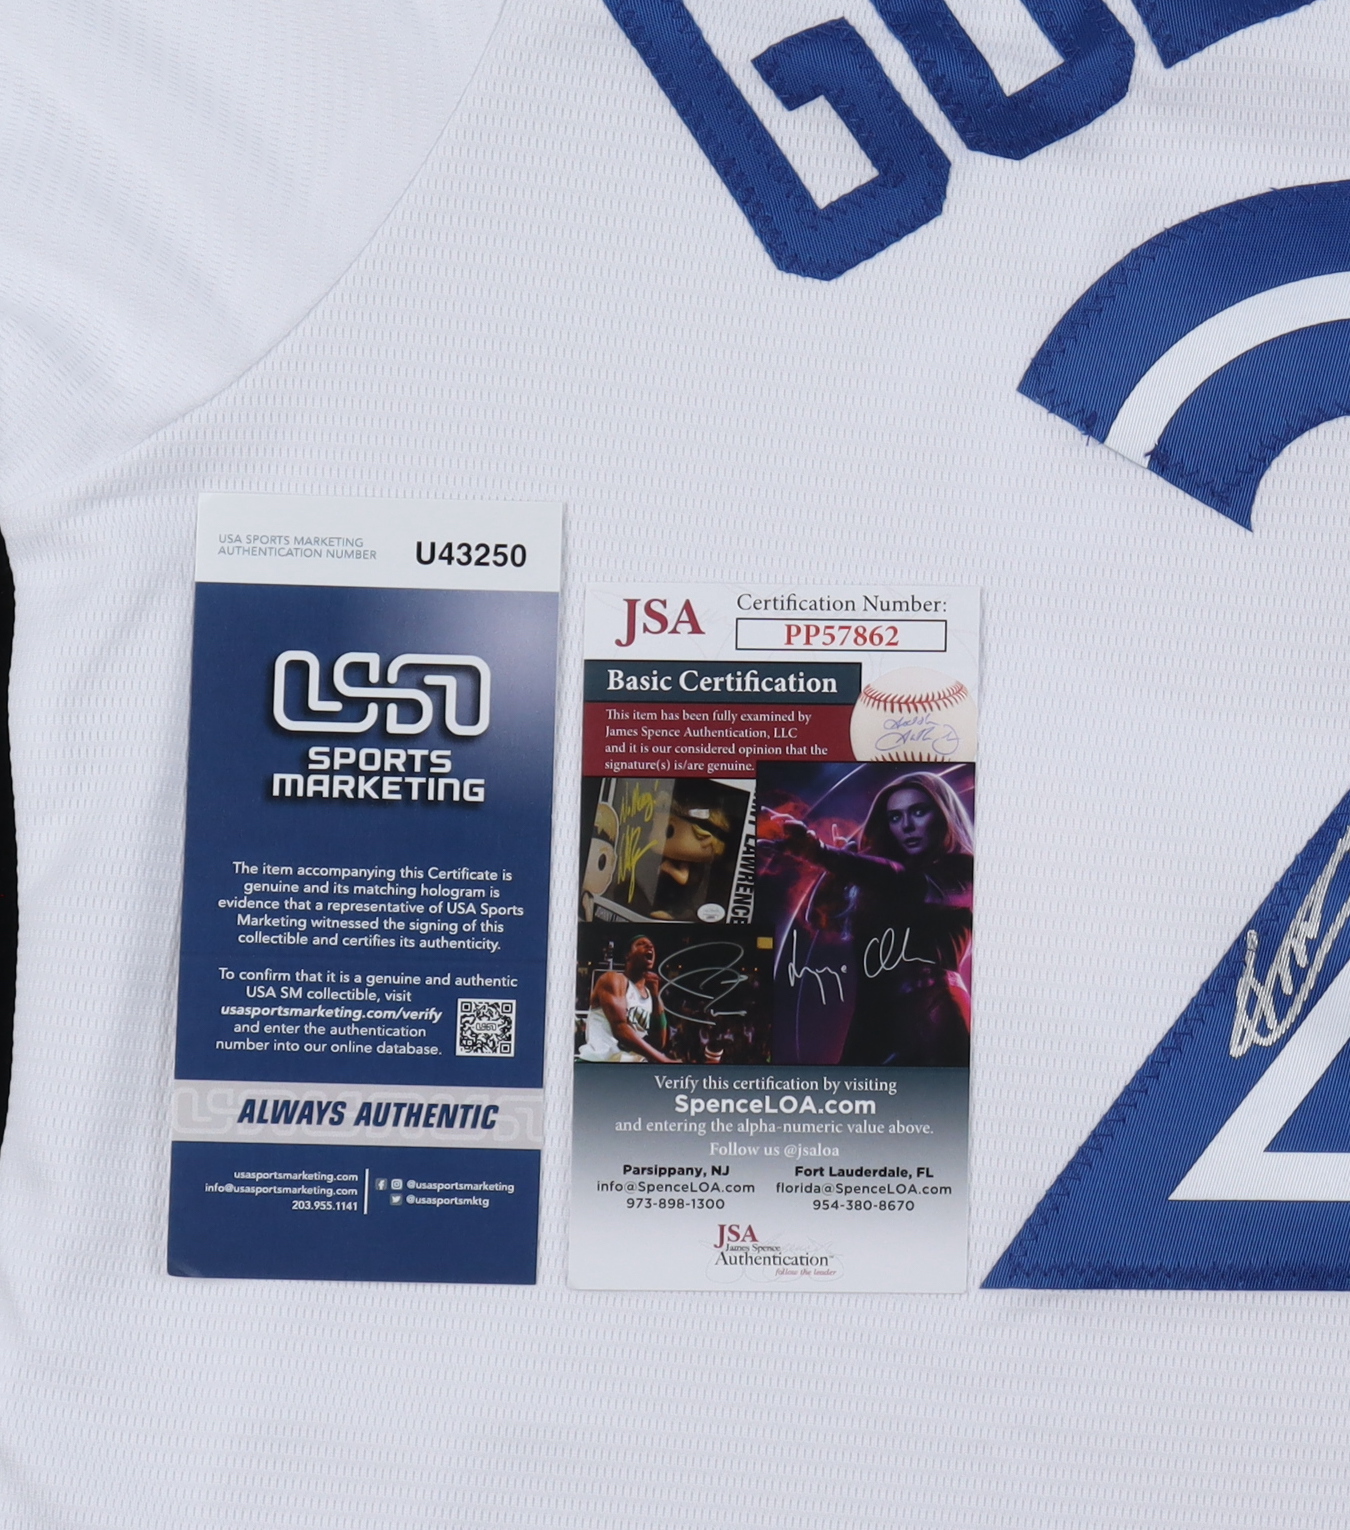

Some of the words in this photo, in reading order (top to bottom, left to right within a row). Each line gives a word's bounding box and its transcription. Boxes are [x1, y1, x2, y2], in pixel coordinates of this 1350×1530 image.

[219, 534, 242, 544] USA
[246, 535, 290, 545] SPORTS
[294, 536, 363, 547] MARKETING
[218, 546, 323, 558] AUTHENTICATION
[326, 549, 377, 560] NUMBER
[416, 541, 527, 567] U43250
[736, 594, 856, 612] Certification
[862, 595, 947, 613] Number:
[615, 598, 705, 647] JSA
[784, 624, 899, 647] PP57862
[607, 669, 672, 692] Basic
[678, 670, 838, 693] Certification
[605, 709, 628, 721] This
[631, 710, 657, 721] item
[661, 710, 678, 721] has
[682, 710, 709, 722] been
[713, 710, 737, 724] fully
[741, 711, 794, 723] examined
[797, 711, 811, 724] by
[605, 727, 637, 738] James
[641, 727, 680, 741] Spence
[684, 727, 770, 740] Authentication,
[774, 728, 797, 739] LLC
[605, 743, 625, 754] and
[629, 743, 637, 754] it
[641, 744, 649, 754] is
[652, 746, 671, 755] our
[675, 744, 734, 755] considered
[738, 745, 782, 758] opinion
[786, 745, 807, 755] that
[810, 745, 828, 755] the
[308, 746, 451, 773] SPORTS
[605, 759, 670, 772] signature(s)
[674, 760, 704, 772] is/are
[707, 761, 754, 774] genuine.
[272, 773, 485, 802] MARKETING
[233, 862, 258, 875] The
[263, 863, 293, 875] item
[297, 865, 396, 881] accompanying
[400, 865, 424, 879] this
[428, 867, 498, 881] Certificate
[502, 869, 512, 881] is
[244, 882, 299, 895] genuine
[303, 881, 329, 894] and
[333, 882, 350, 894] its
[353, 883, 417, 899] matching
[420, 885, 485, 899] hologram
[489, 886, 500, 898] is
[218, 897, 280, 909] evidence
[284, 898, 311, 910] that
[315, 902, 323, 911] a
[327, 900, 424, 915] representative
[428, 902, 443, 914] of
[447, 902, 476, 915] USA
[480, 903, 524, 917] Sports
[237, 914, 307, 930] Marketing
[311, 916, 379, 930] witnessed
[383, 918, 405, 930] the
[409, 919, 458, 934] signing
[462, 920, 477, 932] of
[480, 920, 504, 933] this
[238, 933, 308, 945] collectible
[312, 934, 338, 946] and
[342, 934, 396, 947] certifies
[400, 936, 415, 947] its
[419, 937, 501, 952] authenticity.
[219, 967, 235, 980] To
[239, 968, 291, 982] confirm
[295, 971, 322, 982] that
[326, 970, 336, 982] it
[339, 971, 350, 983] is
[354, 975, 362, 984] a
[366, 973, 421, 987] genuine
[425, 973, 450, 985] and
[455, 974, 518, 987] authentic
[246, 986, 277, 998] USA
[280, 987, 303, 999] SM
[307, 988, 380, 1002] collectible,
[385, 990, 412, 1001] visit
[221, 1004, 443, 1023] usasportsmarketing.com/verify
[234, 1021, 260, 1033] and
[264, 1023, 299, 1034] enter
[303, 1023, 326, 1034] the
[330, 1024, 426, 1037] authentication
[216, 1039, 270, 1051] number
[273, 1040, 300, 1051] into
[304, 1043, 326, 1052] our
[330, 1042, 373, 1053] online
[376, 1042, 442, 1055] database.
[654, 1076, 699, 1092] Verify
[703, 1076, 729, 1090] this
[733, 1077, 819, 1091] certification
[823, 1077, 841, 1093] by
[844, 1078, 897, 1094] visiting
[674, 1094, 876, 1117] SpenceLOA.com
[237, 1099, 346, 1126] ALWAYS
[353, 1102, 499, 1129] AUTHENTIC
[615, 1119, 642, 1132] and
[646, 1119, 707, 1135] entering
[710, 1120, 733, 1133] the
[737, 1120, 843, 1136] alpha-numeric
[847, 1121, 884, 1134] value
[888, 1122, 934, 1135] above.
[710, 1142, 760, 1155] Follow
[764, 1147, 780, 1156] us
[784, 1144, 840, 1160] @jsaloa
[234, 1170, 358, 1182] usasportsmarketing.com
[623, 1164, 707, 1178] Parsippany,
[711, 1165, 730, 1176] NJ
[795, 1166, 825, 1178] Fort
[829, 1166, 913, 1180] Lauderdale,
[916, 1167, 934, 1178] FL
[205, 1182, 358, 1197] info@usasportsmarketing.com
[406, 1180, 515, 1193] @usasportsmarketing
[597, 1181, 755, 1194] info@SpenceLOA.com
[776, 1183, 952, 1195] florida@SpenceLOA.com
[292, 1200, 357, 1211] 203.955.1141
[406, 1194, 489, 1207] @usasportsmktg
[626, 1198, 725, 1209] 973-898-1300
[812, 1200, 915, 1211] 954-380-8670
[714, 1223, 758, 1248] JSA
[726, 1243, 750, 1252] James
[752, 1243, 780, 1253] Spence
